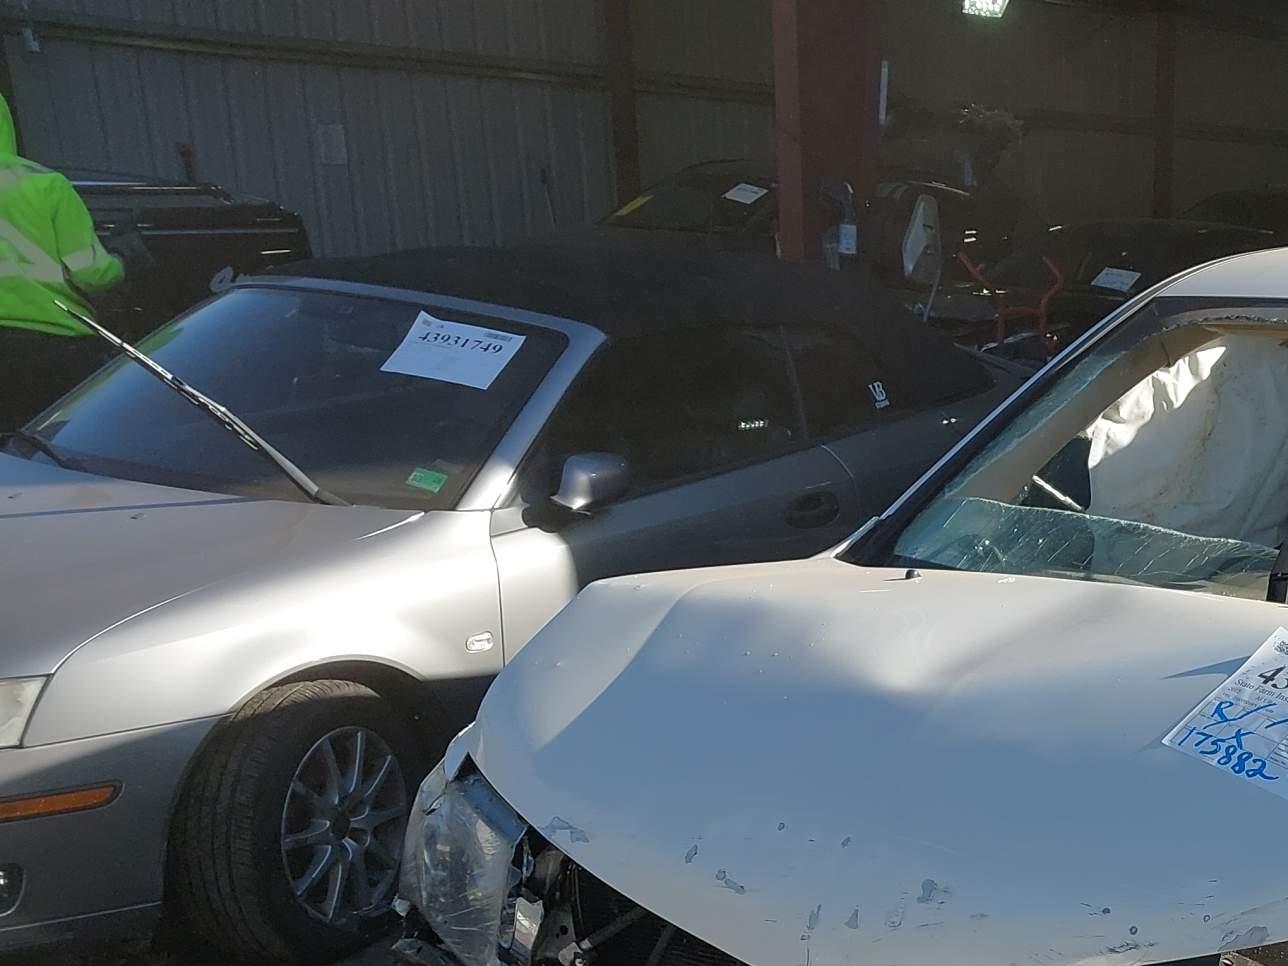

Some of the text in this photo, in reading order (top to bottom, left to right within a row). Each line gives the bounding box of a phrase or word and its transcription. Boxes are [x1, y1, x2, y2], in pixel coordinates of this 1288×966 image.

[417, 331, 504, 354] 43931749
[1234, 678, 1256, 691] State
[1255, 685, 1276, 698] Farm
